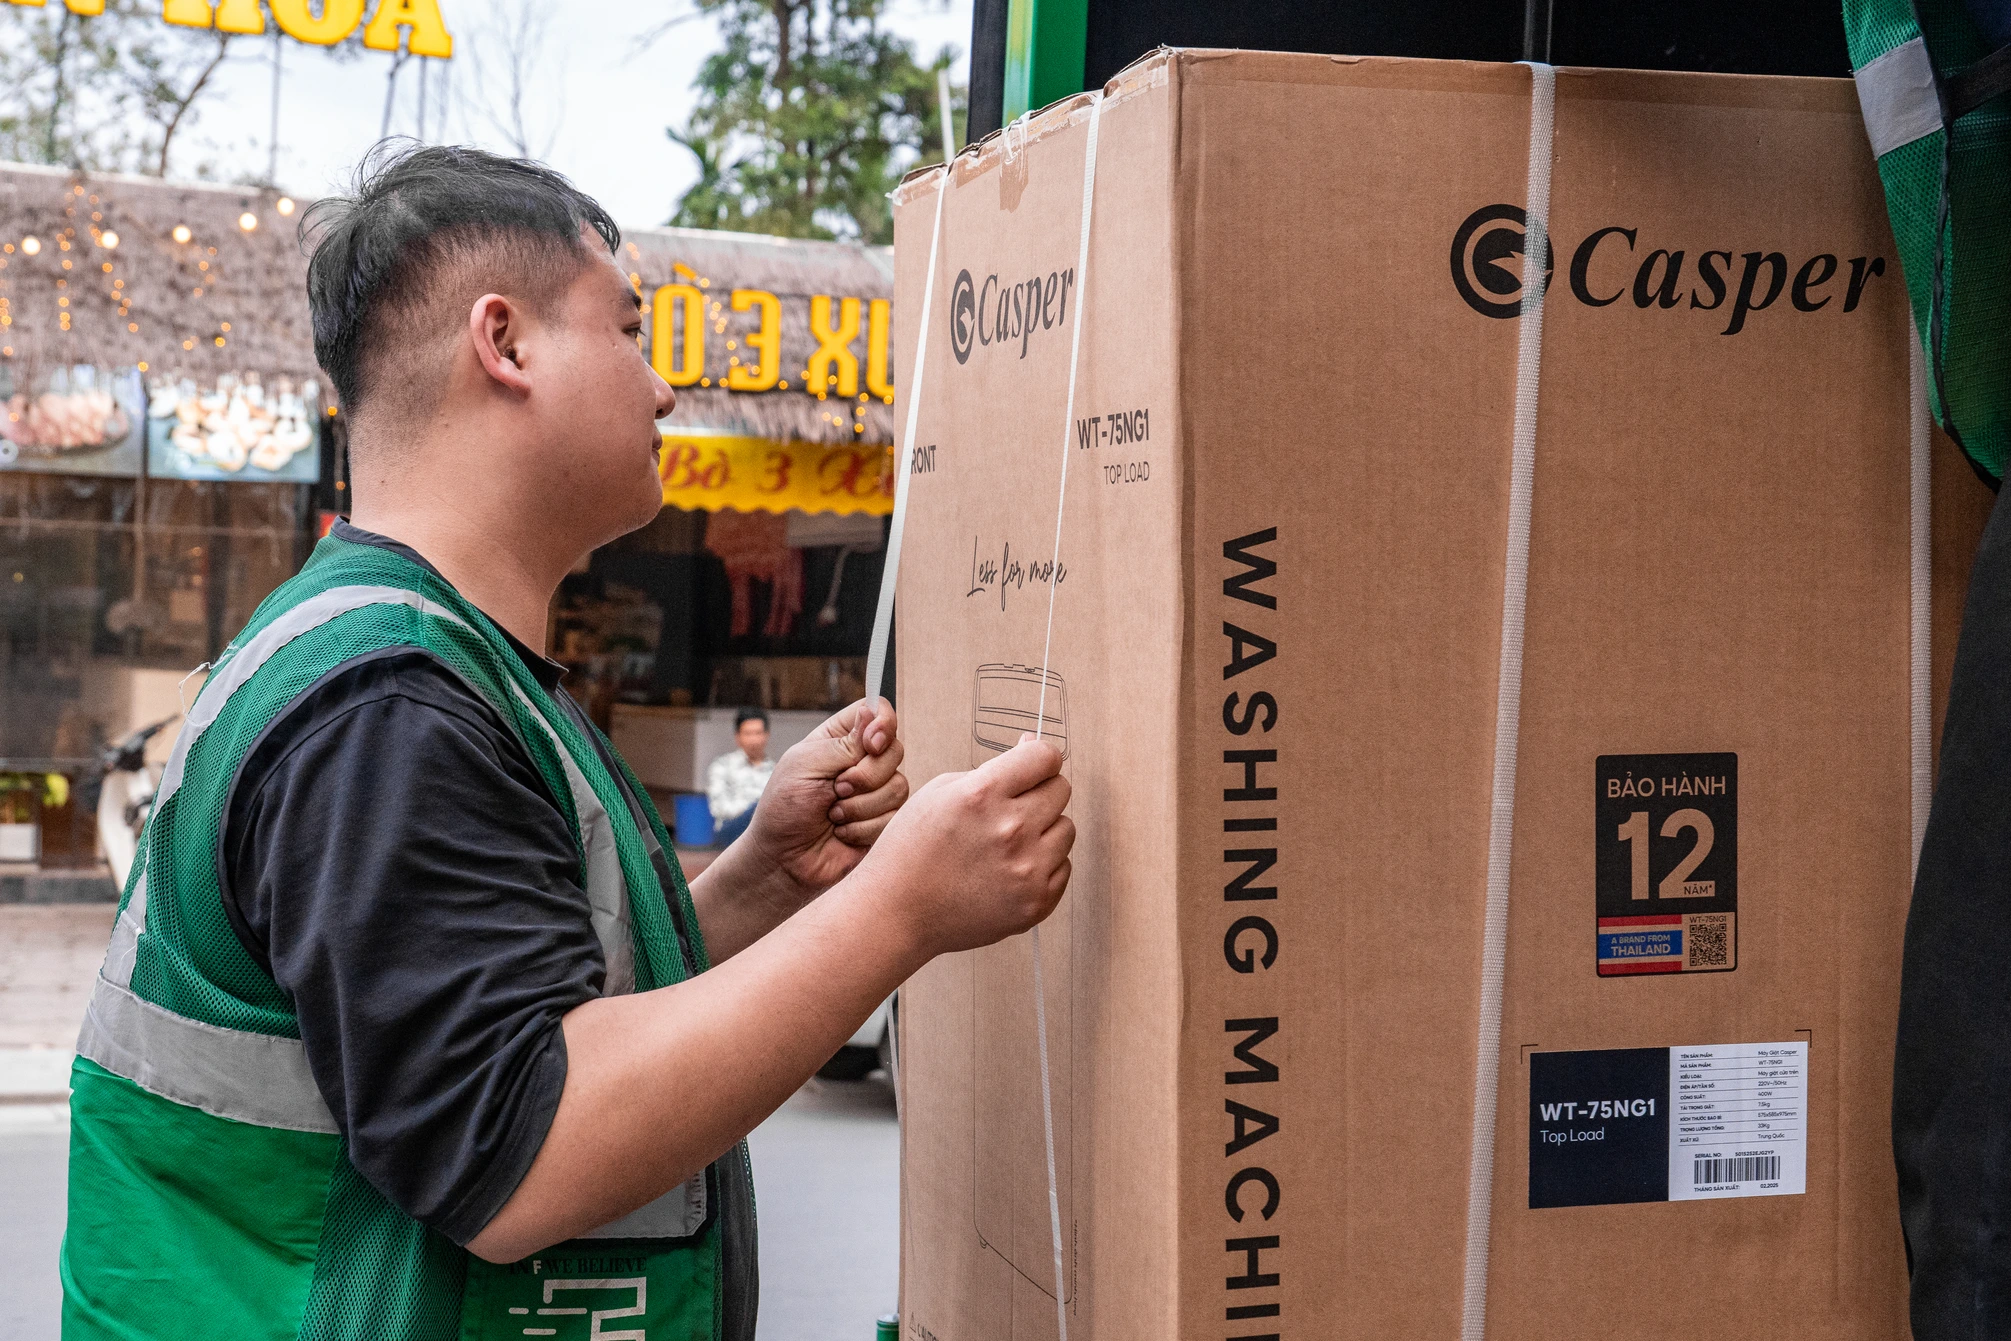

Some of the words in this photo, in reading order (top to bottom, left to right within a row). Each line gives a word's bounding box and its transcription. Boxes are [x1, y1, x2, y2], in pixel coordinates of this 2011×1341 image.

[1569, 225, 1886, 336] Casper
[651, 262, 704, 387] Ò
[728, 288, 782, 391] 3
[976, 266, 1074, 360] Casper
[1077, 408, 1150, 450] WT-75NG1
[754, 450, 793, 494] 3
[911, 445, 937, 475] RONT
[1104, 464, 1122, 485] TOP
[1125, 461, 1150, 484] LOAD
[966, 535, 997, 598] Less
[1001, 541, 1024, 612] for
[1030, 559, 1067, 589] more
[1221, 526, 1279, 975] WASHING
[1608, 771, 1655, 798] BẢO
[1662, 771, 1726, 797] HÀNH
[1617, 808, 1715, 900] 12
[1689, 916, 1727, 924] WT-75NG1
[1611, 943, 1671, 956] THAILAND
[1619, 935, 1646, 944] BRAND
[1647, 934, 1670, 943] FROM
[1540, 1098, 1655, 1122] WT-75NG1
[1540, 1129, 1567, 1146] Top
[1570, 1127, 1605, 1142] Load
[1224, 1016, 1281, 1341] MACHI
[532, 1260, 542, 1275] F
[545, 1258, 573, 1274] WE
[577, 1257, 647, 1274] BELIEVE
